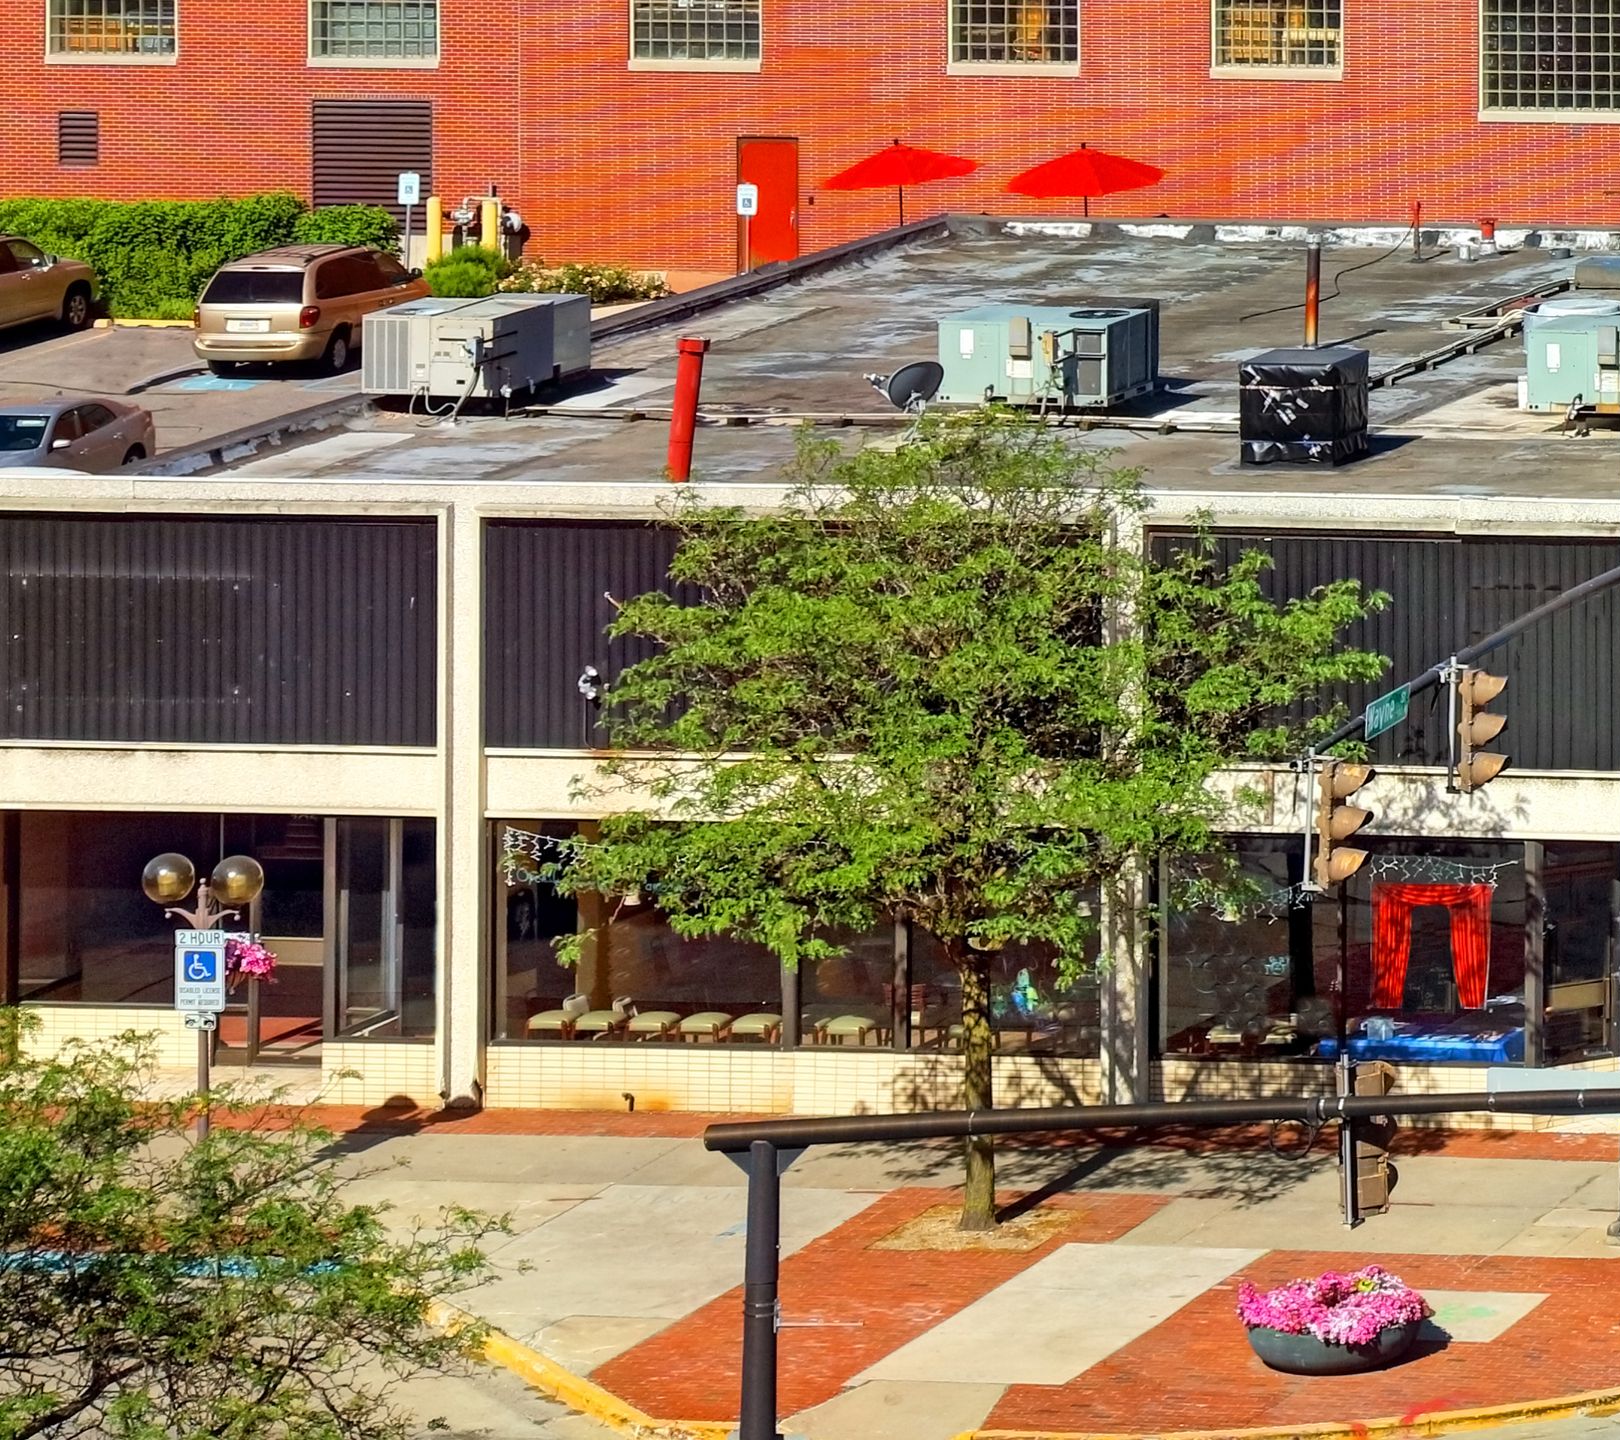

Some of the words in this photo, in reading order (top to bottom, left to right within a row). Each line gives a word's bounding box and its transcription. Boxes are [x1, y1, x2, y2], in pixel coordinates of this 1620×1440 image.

[1368, 700, 1395, 732] Wayne
[179, 932, 186, 944] 2
[190, 932, 220, 945] HOUR
